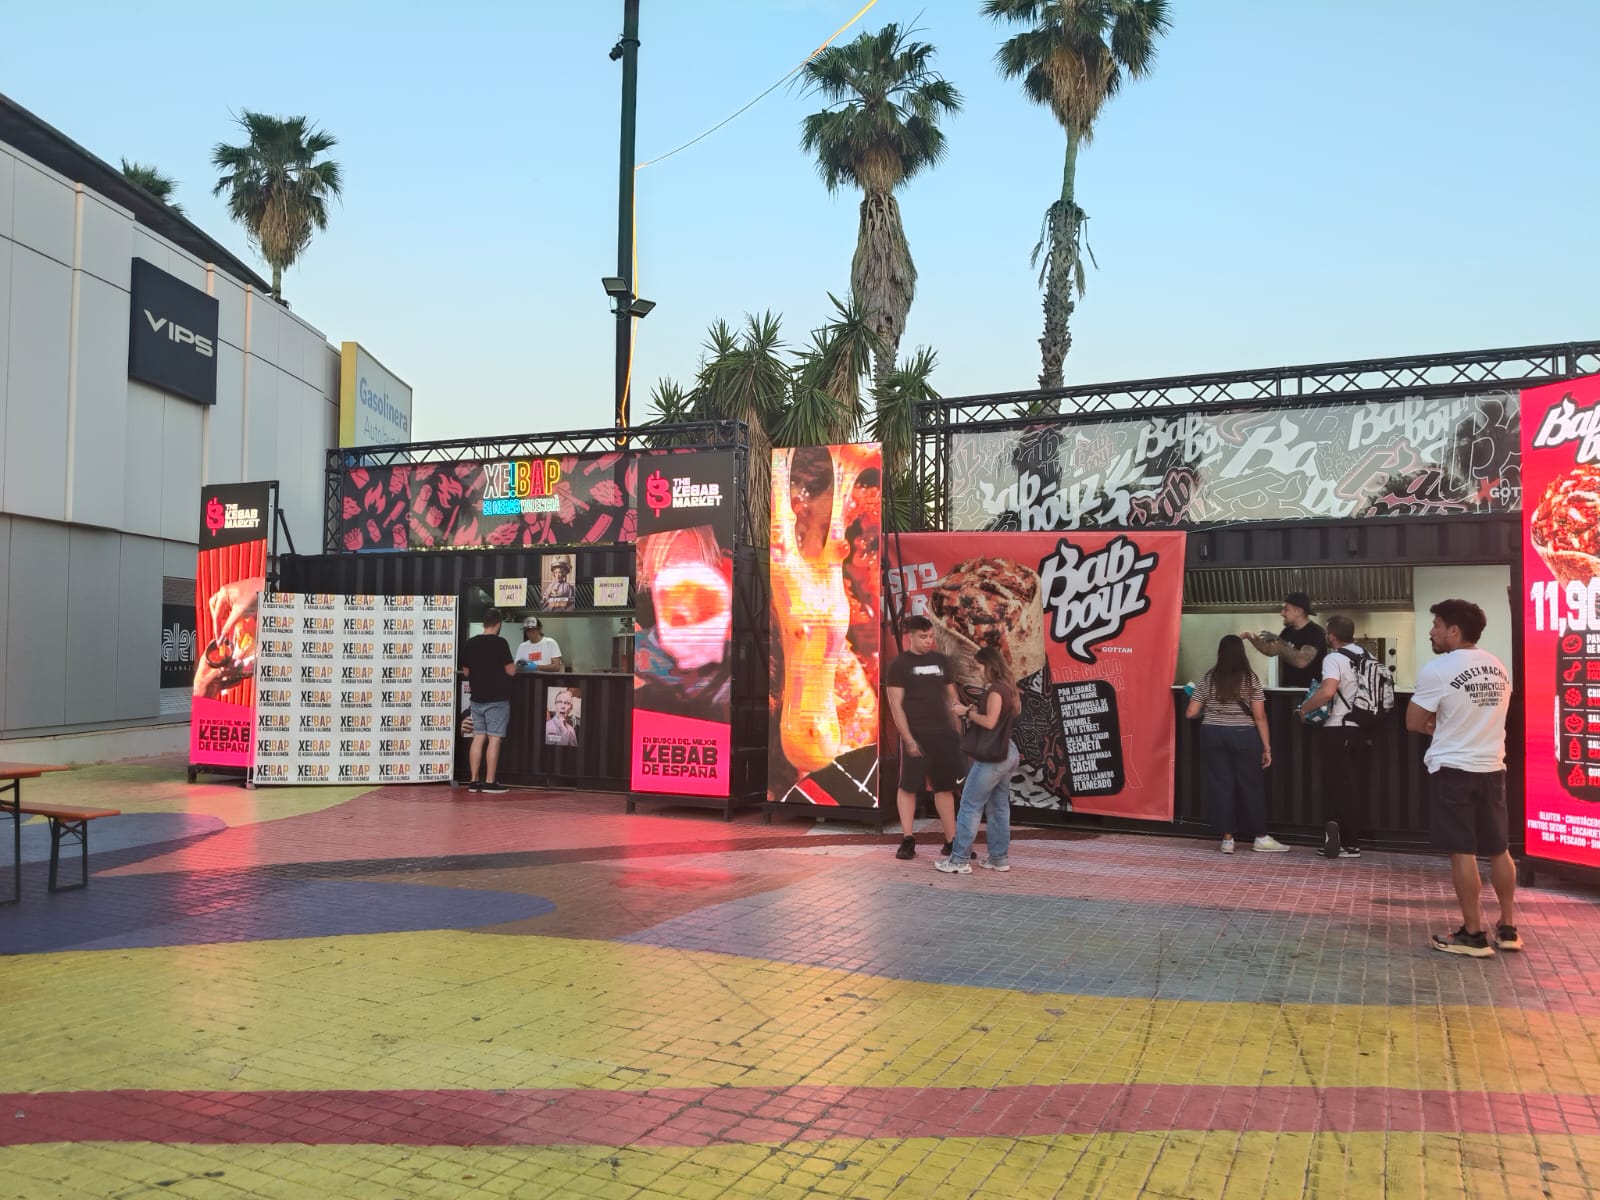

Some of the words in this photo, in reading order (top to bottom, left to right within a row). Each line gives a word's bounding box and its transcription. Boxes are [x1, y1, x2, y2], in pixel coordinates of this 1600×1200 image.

[143, 309, 213, 358] VIPS
[359, 376, 408, 433] Gasolinera
[483, 459, 561, 499] XE!BAP
[673, 477, 691, 487] THE
[672, 483, 720, 497] KEBAB
[672, 494, 723, 508] MARKET
[224, 509, 258, 520] KEBAB
[224, 518, 260, 528] MARKET
[263, 616, 294, 627] XE!BAP
[303, 618, 334, 629] XE!BAP
[343, 618, 374, 630] XE!BAP
[383, 618, 414, 630] XE!BAP
[422, 618, 453, 630] XE!BAP
[262, 640, 293, 652] XE!BAP
[302, 642, 333, 653] XE!BAP
[342, 643, 373, 654] XE!BAP
[383, 643, 414, 654] XE!BAP
[422, 643, 453, 654] XE!BAP
[261, 666, 292, 676] XE!BAP
[301, 666, 332, 677] XE!BAP
[342, 667, 373, 678] XE!BAP
[382, 667, 413, 678] XE!BAP
[421, 667, 452, 678] XE!BAP
[1450, 670, 1472, 690] DEUS
[1470, 666, 1482, 677] EX
[1464, 682, 1505, 692] MOTORCYCLES
[260, 690, 291, 701] XE!BAP
[300, 691, 331, 702] XE!BAP
[341, 692, 372, 703] XE!BAP
[381, 691, 412, 702] XE!BAP
[421, 691, 452, 702] XE!BAP
[259, 715, 290, 726] XE!BAP
[299, 716, 330, 726] XE!BAP
[340, 716, 371, 727] XE!BAP
[380, 716, 411, 726] XE!BAP
[420, 715, 451, 726] XE!BAP
[199, 725, 250, 742] KEBAB
[199, 741, 211, 751] DE
[258, 740, 289, 751] XE!BAP
[298, 740, 329, 751] XE!BAP
[339, 740, 370, 751] XE!BAP
[380, 740, 411, 751] XE!BAP
[420, 740, 451, 750] XE!BAP
[1066, 741, 1101, 754] SECRETA
[642, 744, 717, 765] KEBAB
[257, 764, 288, 776] XE!BAP
[298, 764, 328, 776] XE!BAP
[338, 764, 370, 776] XE!BAP
[379, 764, 410, 775] XE!BAP
[419, 764, 450, 774] XE!BAP
[642, 763, 659, 775] DE
[662, 764, 717, 779] ESPAÑA
[1070, 759, 1098, 774] CACIK
[1073, 778, 1112, 792] FLAMEADO
